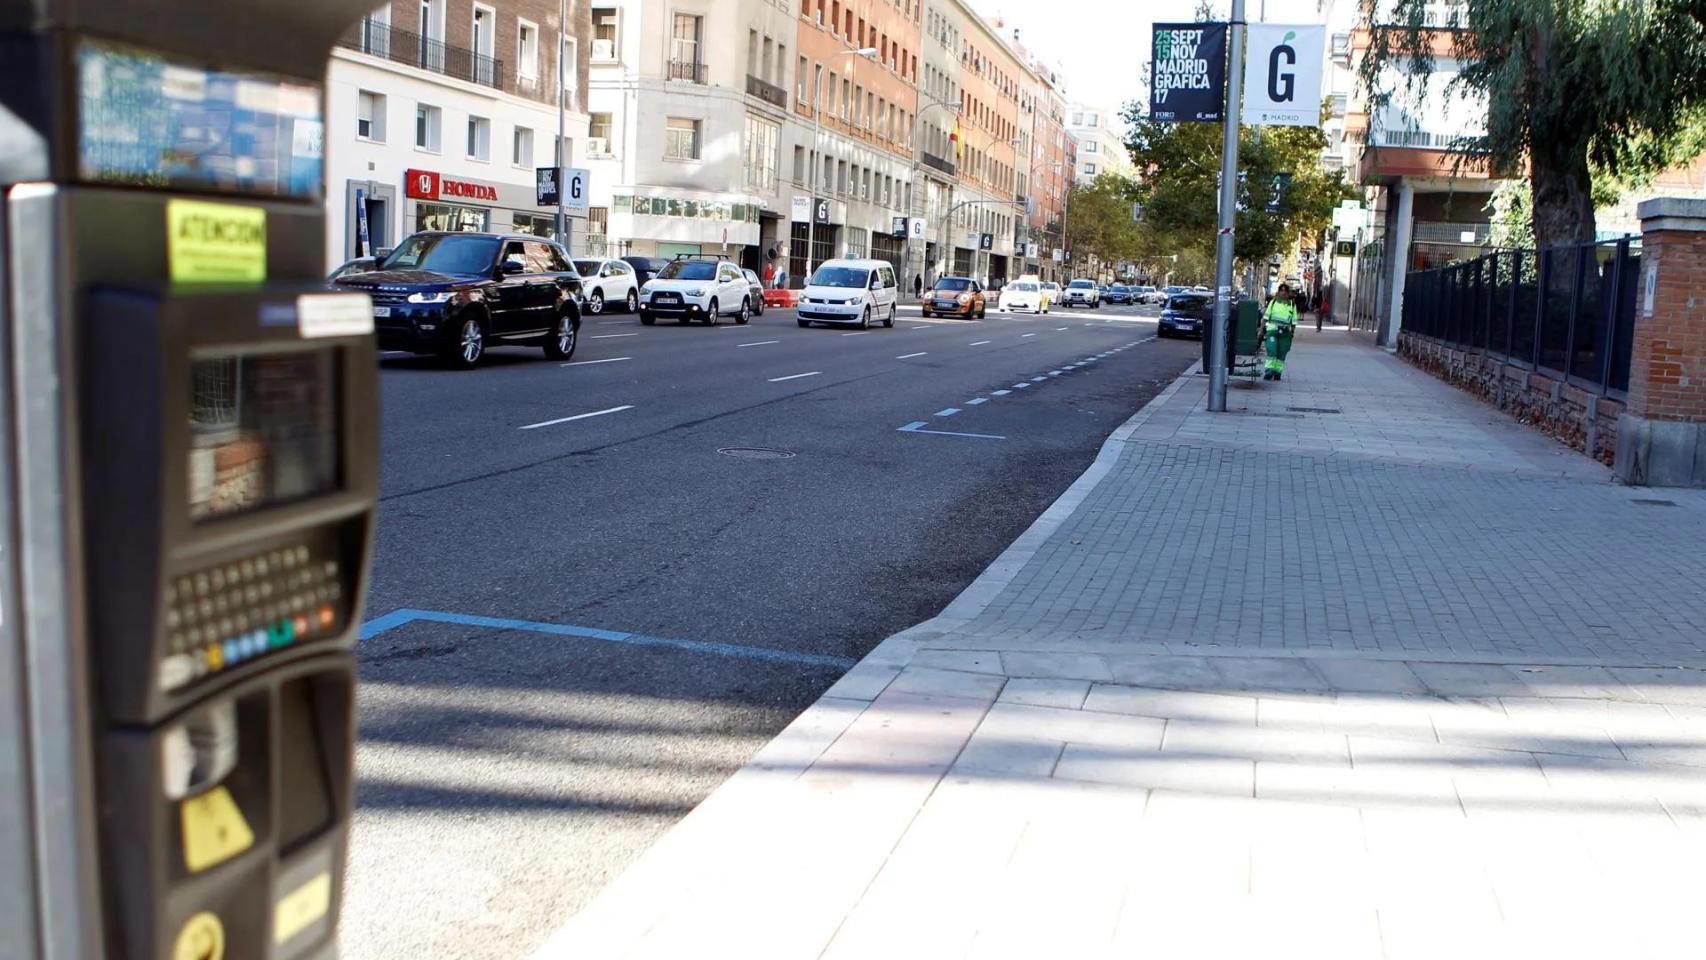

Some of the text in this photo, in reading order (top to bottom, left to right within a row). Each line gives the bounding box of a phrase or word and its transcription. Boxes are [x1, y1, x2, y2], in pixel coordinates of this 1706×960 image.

[1155, 59, 1208, 74] MADRID
[1154, 74, 1211, 89] GRAFICA
[1154, 89, 1169, 104] 17
[1270, 114, 1300, 122] MADRID
[442, 180, 498, 201] HONDA
